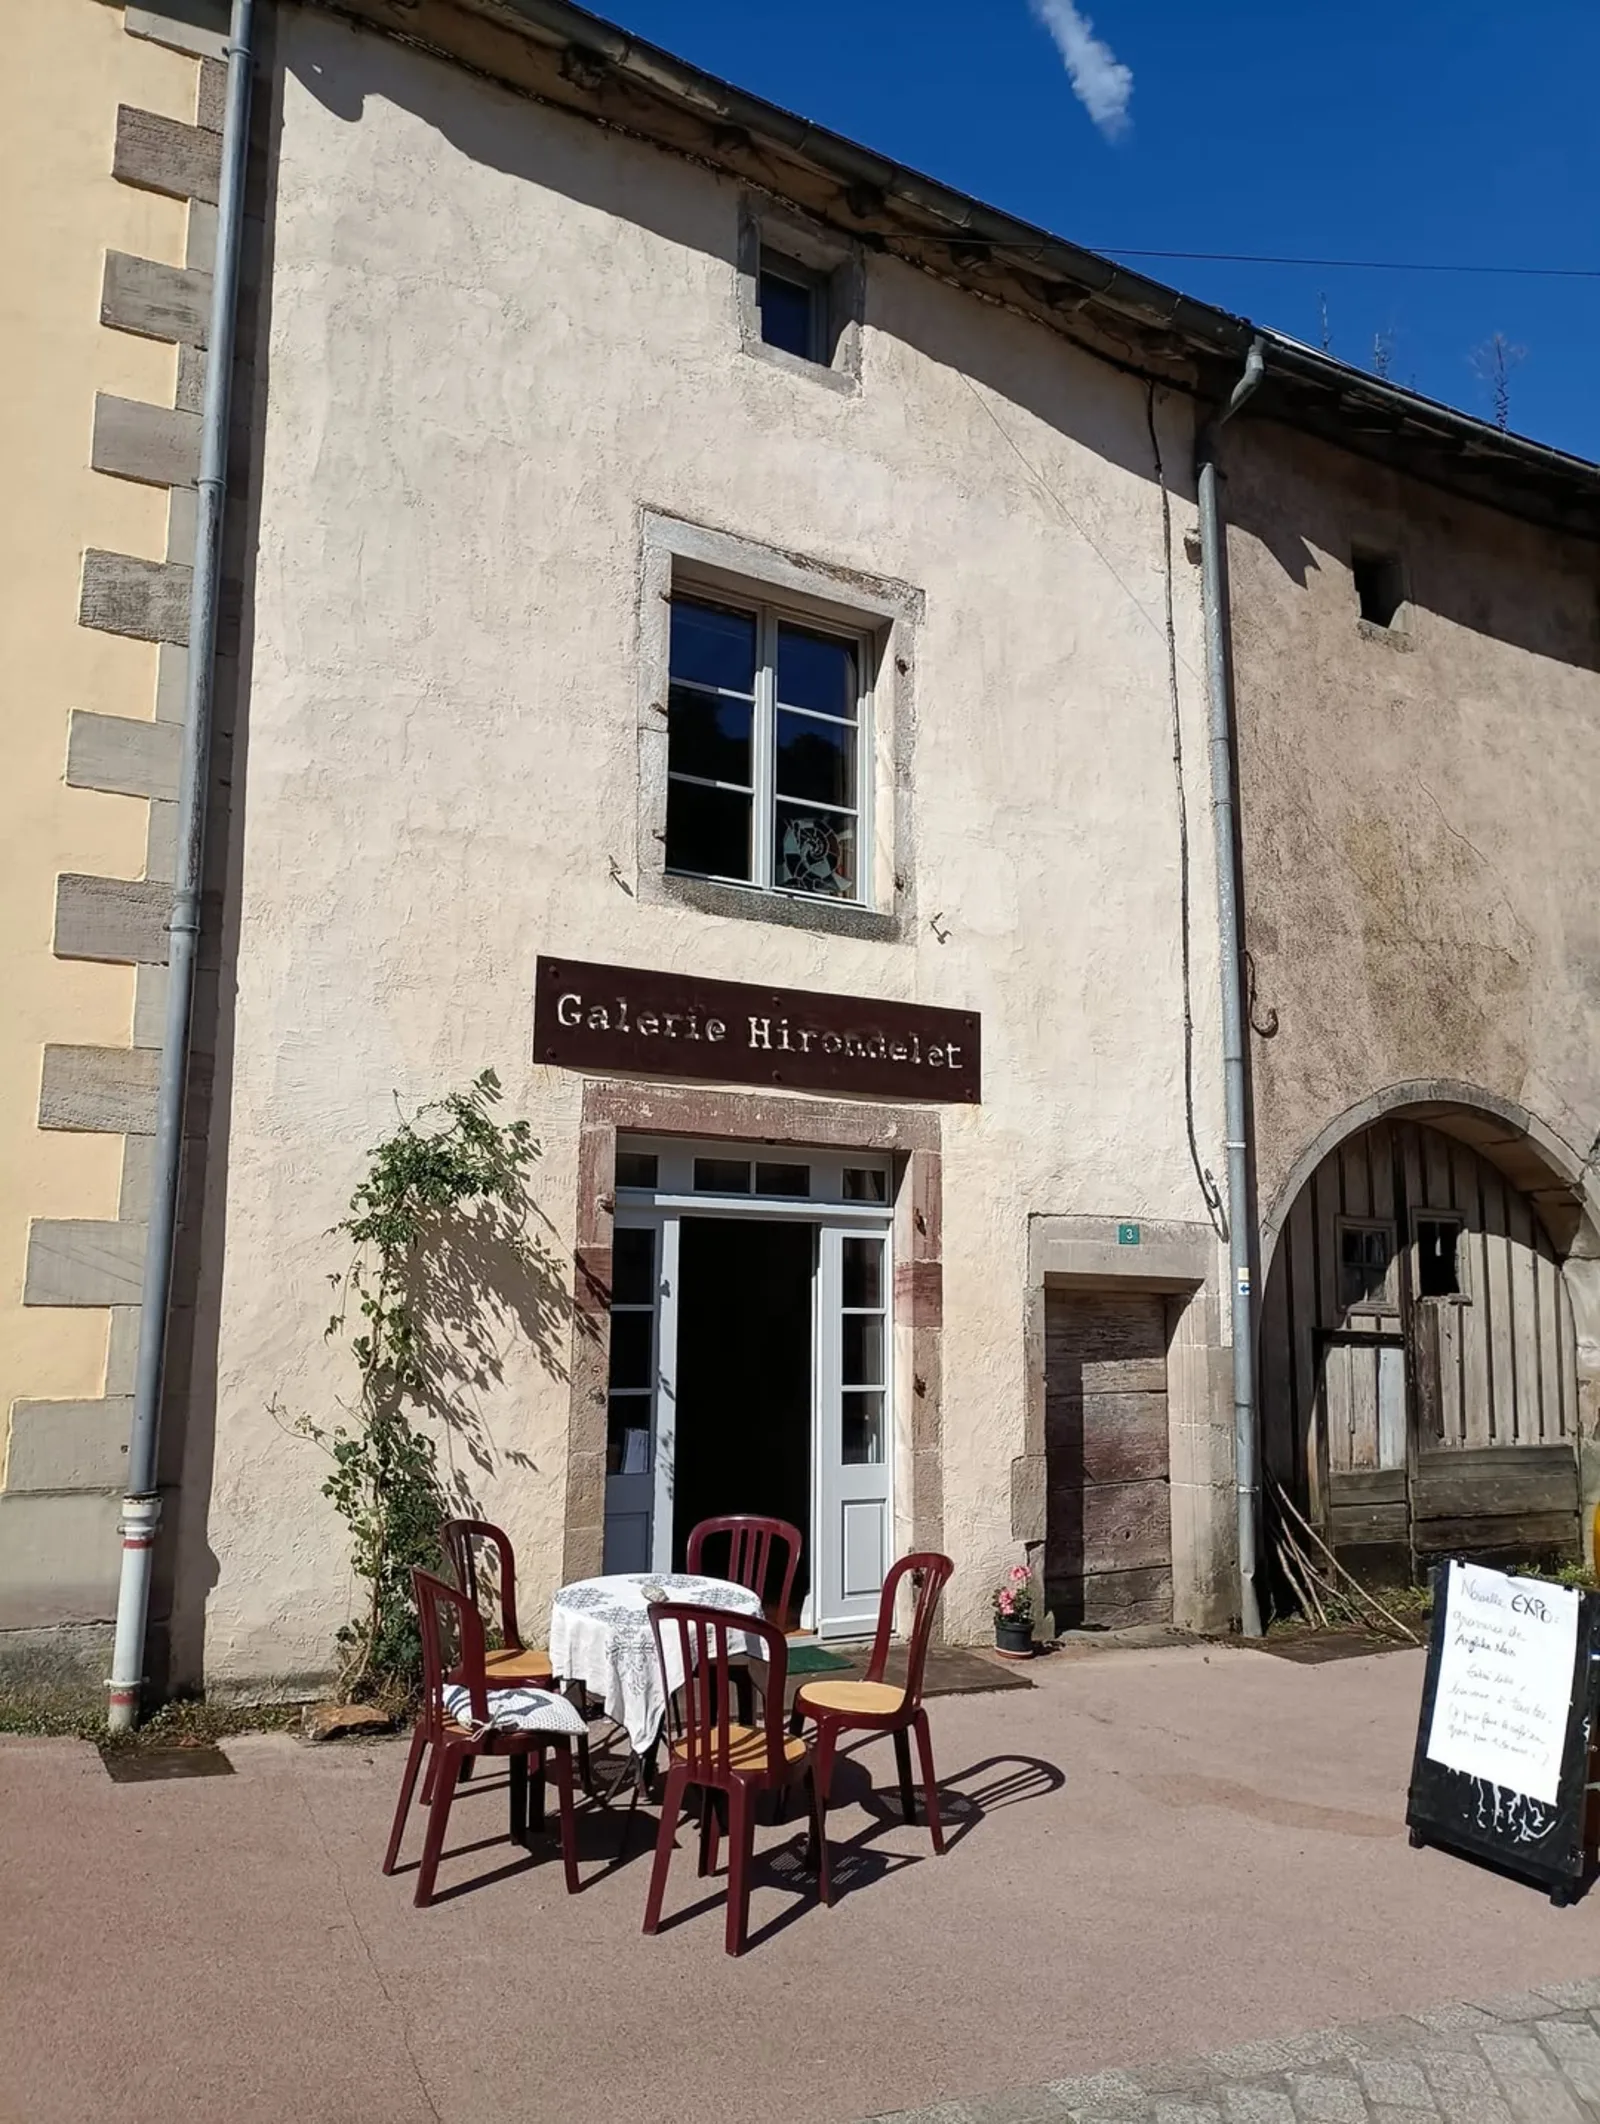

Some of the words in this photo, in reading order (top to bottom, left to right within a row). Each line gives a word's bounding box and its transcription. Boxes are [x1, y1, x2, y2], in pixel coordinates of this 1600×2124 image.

[556, 993, 727, 1043] Galerie
[748, 1015, 964, 1070] Hirondelet
[1125, 1228, 1133, 1240] 3
